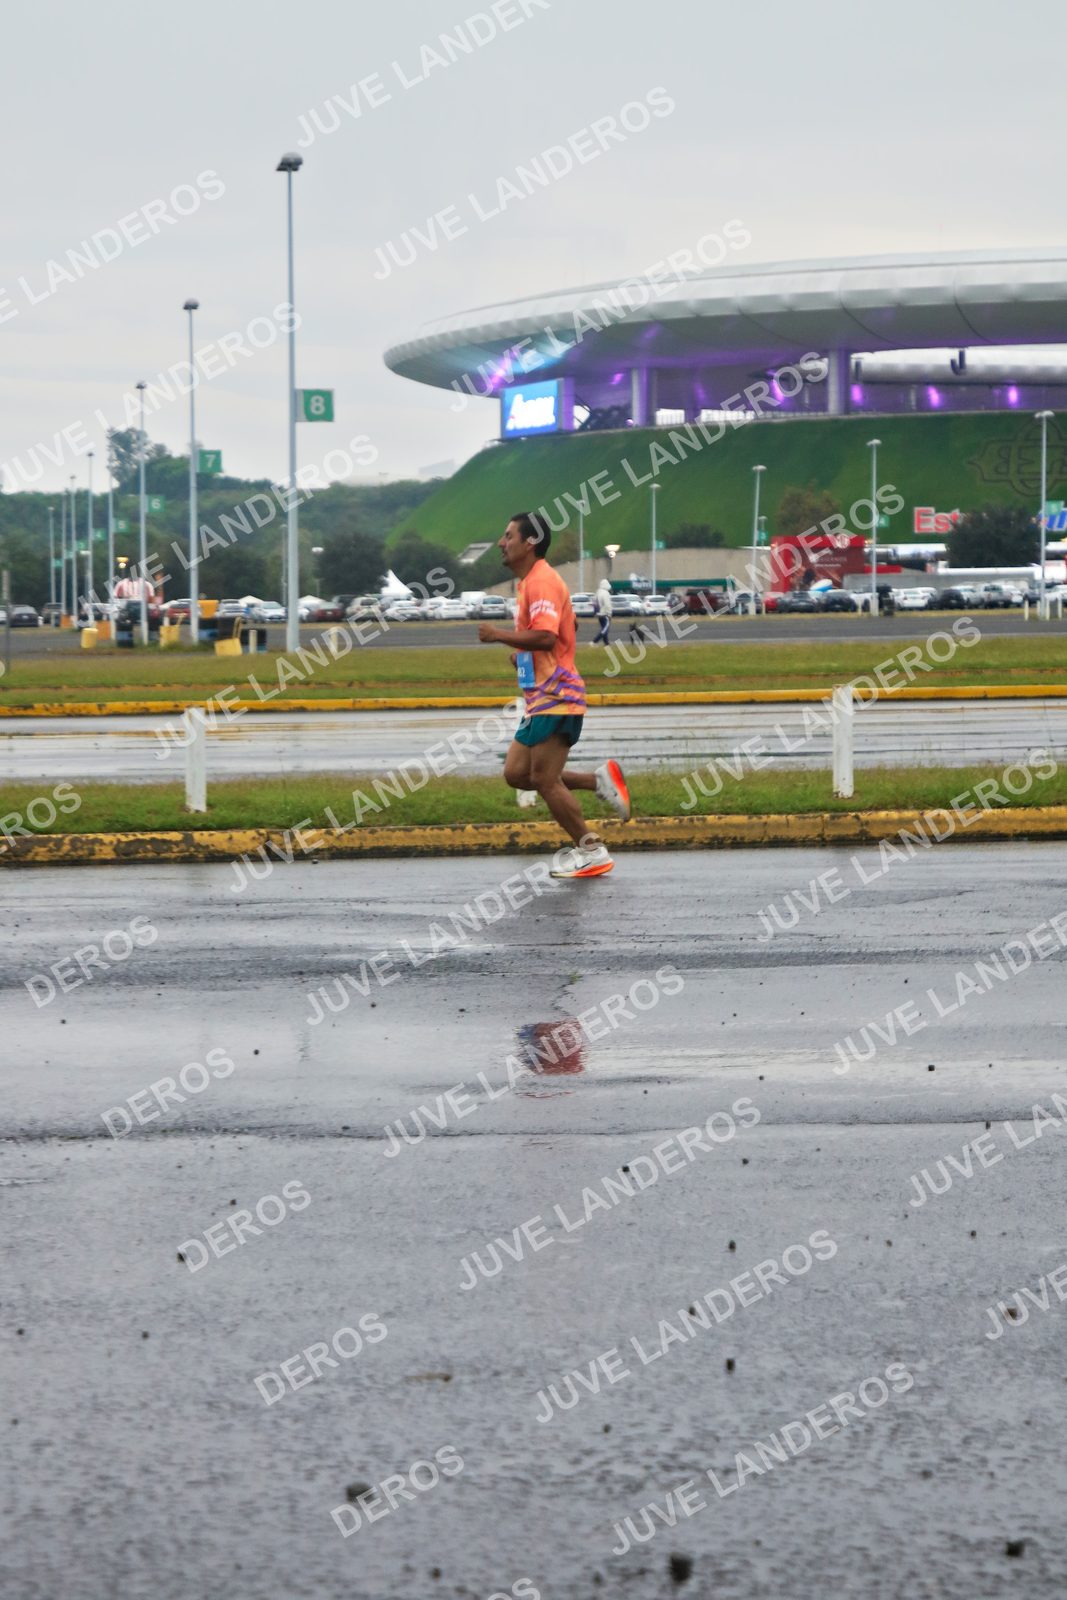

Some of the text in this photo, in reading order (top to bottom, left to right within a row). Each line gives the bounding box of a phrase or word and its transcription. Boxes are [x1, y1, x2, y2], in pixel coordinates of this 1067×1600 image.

[310, 396, 325, 415] 8
[205, 454, 217, 470] 7
[151, 498, 161, 509] 6
